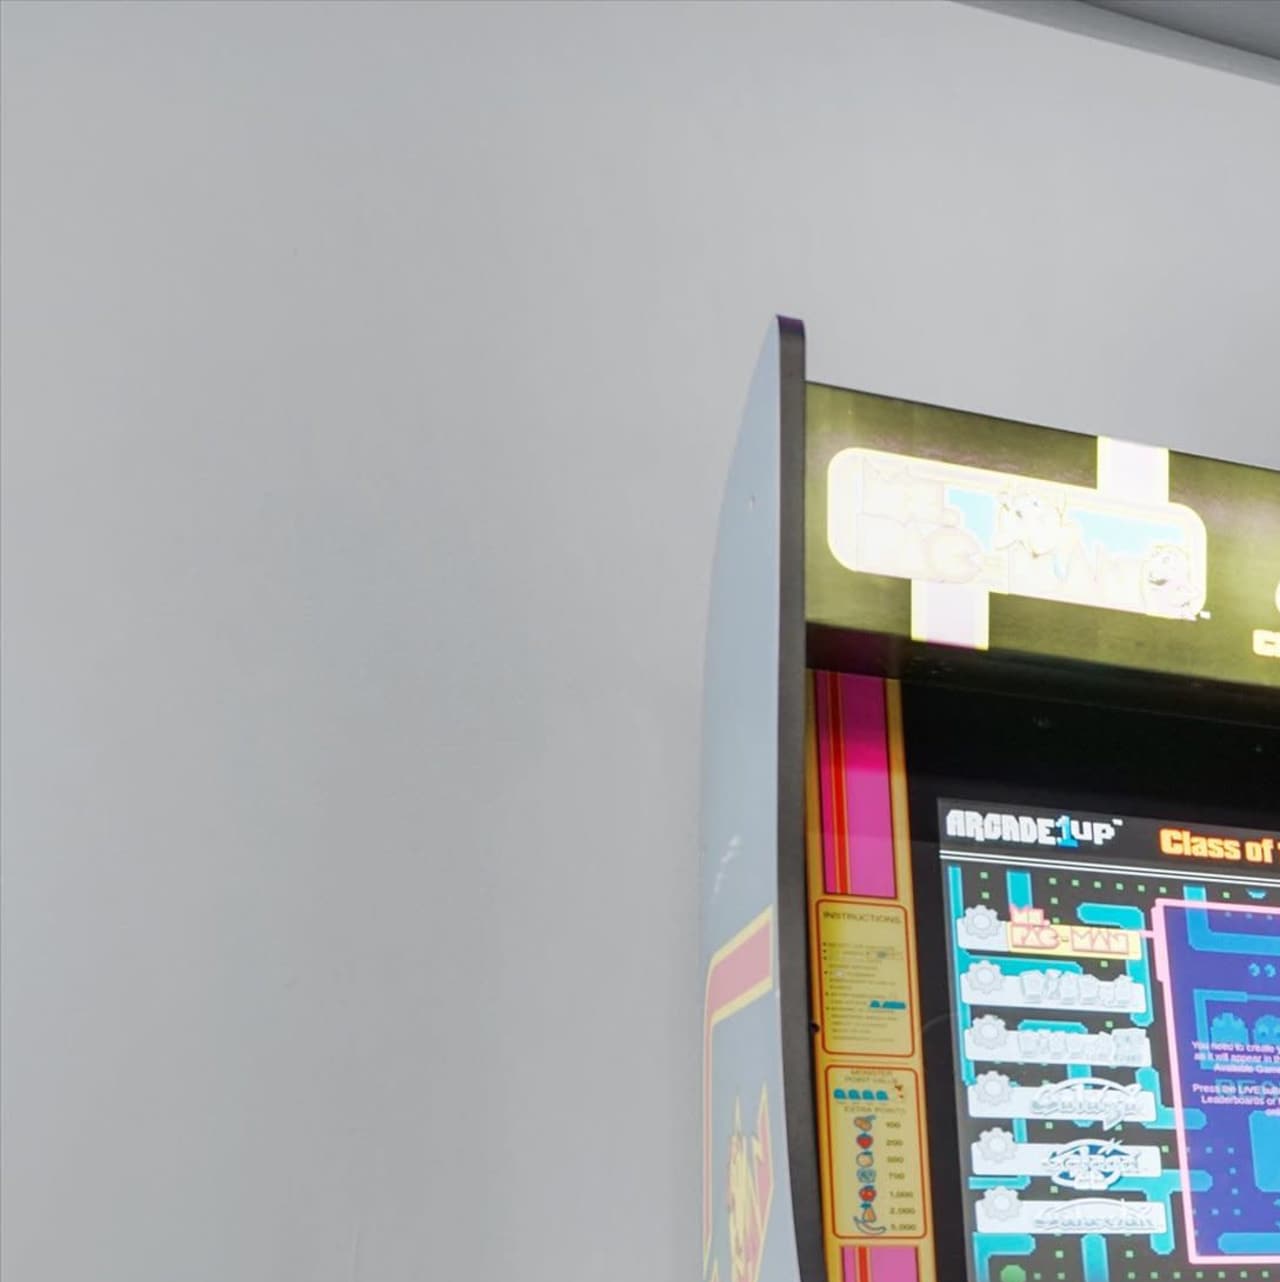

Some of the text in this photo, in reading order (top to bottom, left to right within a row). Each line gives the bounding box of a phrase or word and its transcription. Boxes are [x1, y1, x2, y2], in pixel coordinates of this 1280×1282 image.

[1160, 828, 1240, 861] Class
[1244, 838, 1275, 863] of
[1246, 1044, 1274, 1053] create
